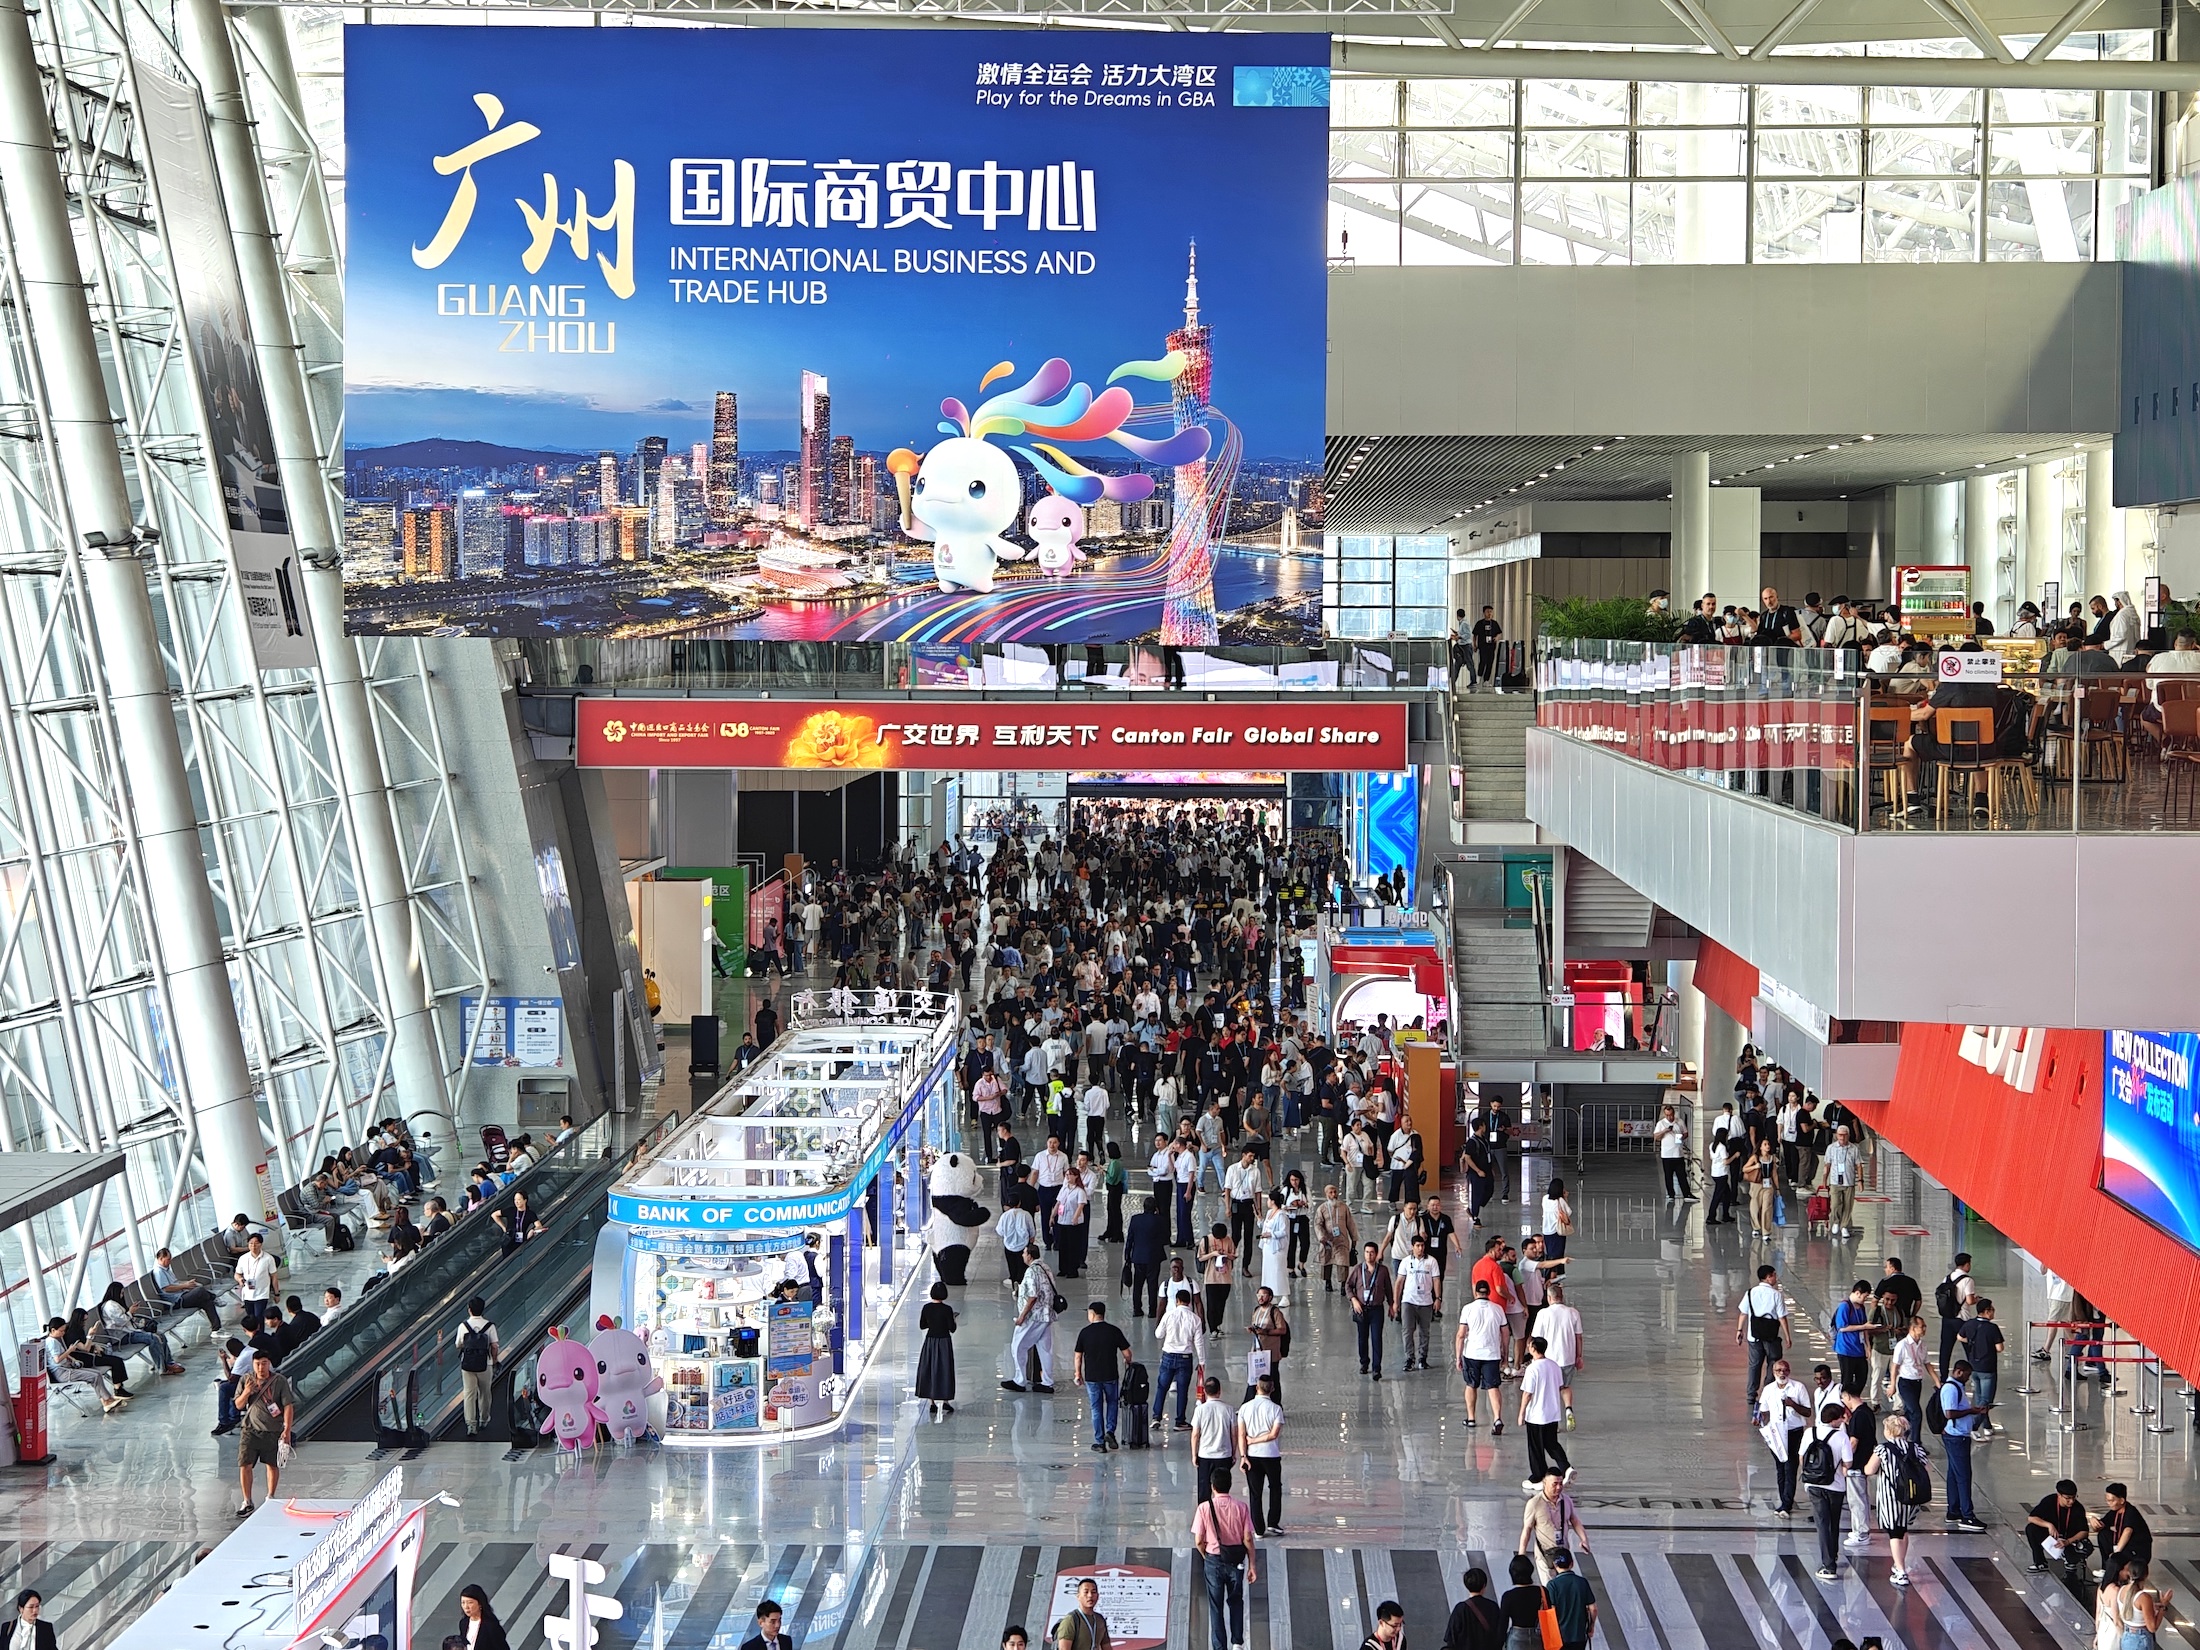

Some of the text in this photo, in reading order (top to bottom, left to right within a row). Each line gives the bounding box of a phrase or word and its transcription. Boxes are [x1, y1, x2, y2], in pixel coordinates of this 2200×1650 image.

[976, 62, 1218, 88] 激情全运会 活力大湾区
[976, 89, 1216, 108] Play for the Dreams in GBA
[411, 92, 637, 299] 广州
[669, 157, 1097, 232] 国际商贸中心
[670, 247, 1096, 276] INTERNATIONAL BUSINESS AND
[437, 283, 586, 317] GUANG
[670, 279, 828, 304] TRADE HUB
[498, 321, 616, 354] ZHOU
[720, 722, 749, 737] 138
[875, 723, 1380, 746] 广交世界 互利天下 Canton Fair Global Share
[2112, 1029, 2188, 1090] NEW COLLECTION
[637, 1204, 690, 1222] BANK
[702, 1208, 733, 1223] OF
[723, 1391, 745, 1406] 好运
